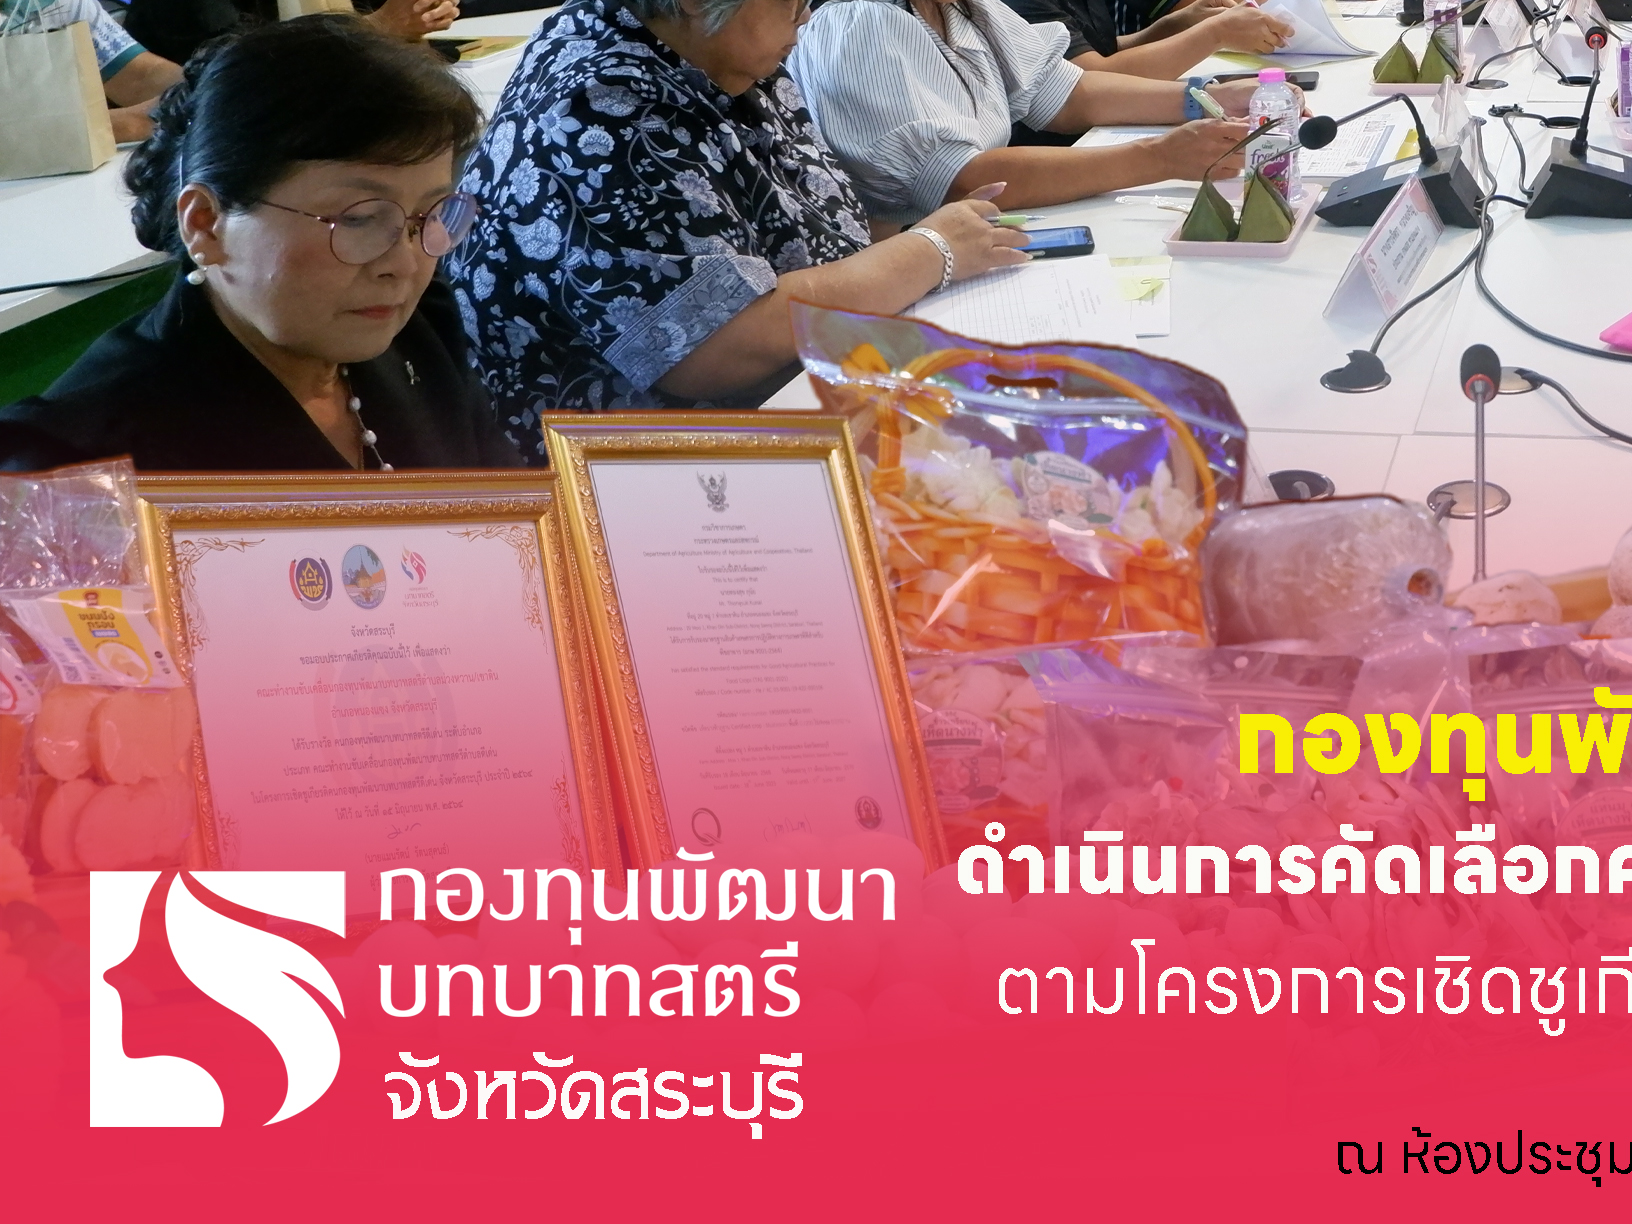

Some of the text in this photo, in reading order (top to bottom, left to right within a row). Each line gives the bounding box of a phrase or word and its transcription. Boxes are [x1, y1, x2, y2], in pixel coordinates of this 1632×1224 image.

[350, 623, 396, 641] จังหวัดสระบุรี
[299, 643, 452, 665] ขอมอบประกาศเกียรติคุณฉบับนี้ไว้ เพื่อแสดงว่า
[330, 698, 439, 720] อำเภอหนองแซง จังหวัดสระบุรี
[291, 724, 483, 751] ได้รับรางวัล คนกองทุนพัฒนาบทบาทสตรีดีเด่น ระดับอำเภอ
[923, 720, 984, 737] เห็ดนางฟ้า
[283, 763, 311, 777] ประเภท
[439, 770, 483, 787] จังหวัดสระบุรี
[484, 767, 511, 782] ประจำปี
[335, 807, 354, 821] ให้ไว้
[364, 802, 380, 817] วันที่
[395, 802, 423, 817] มิถุนายน
